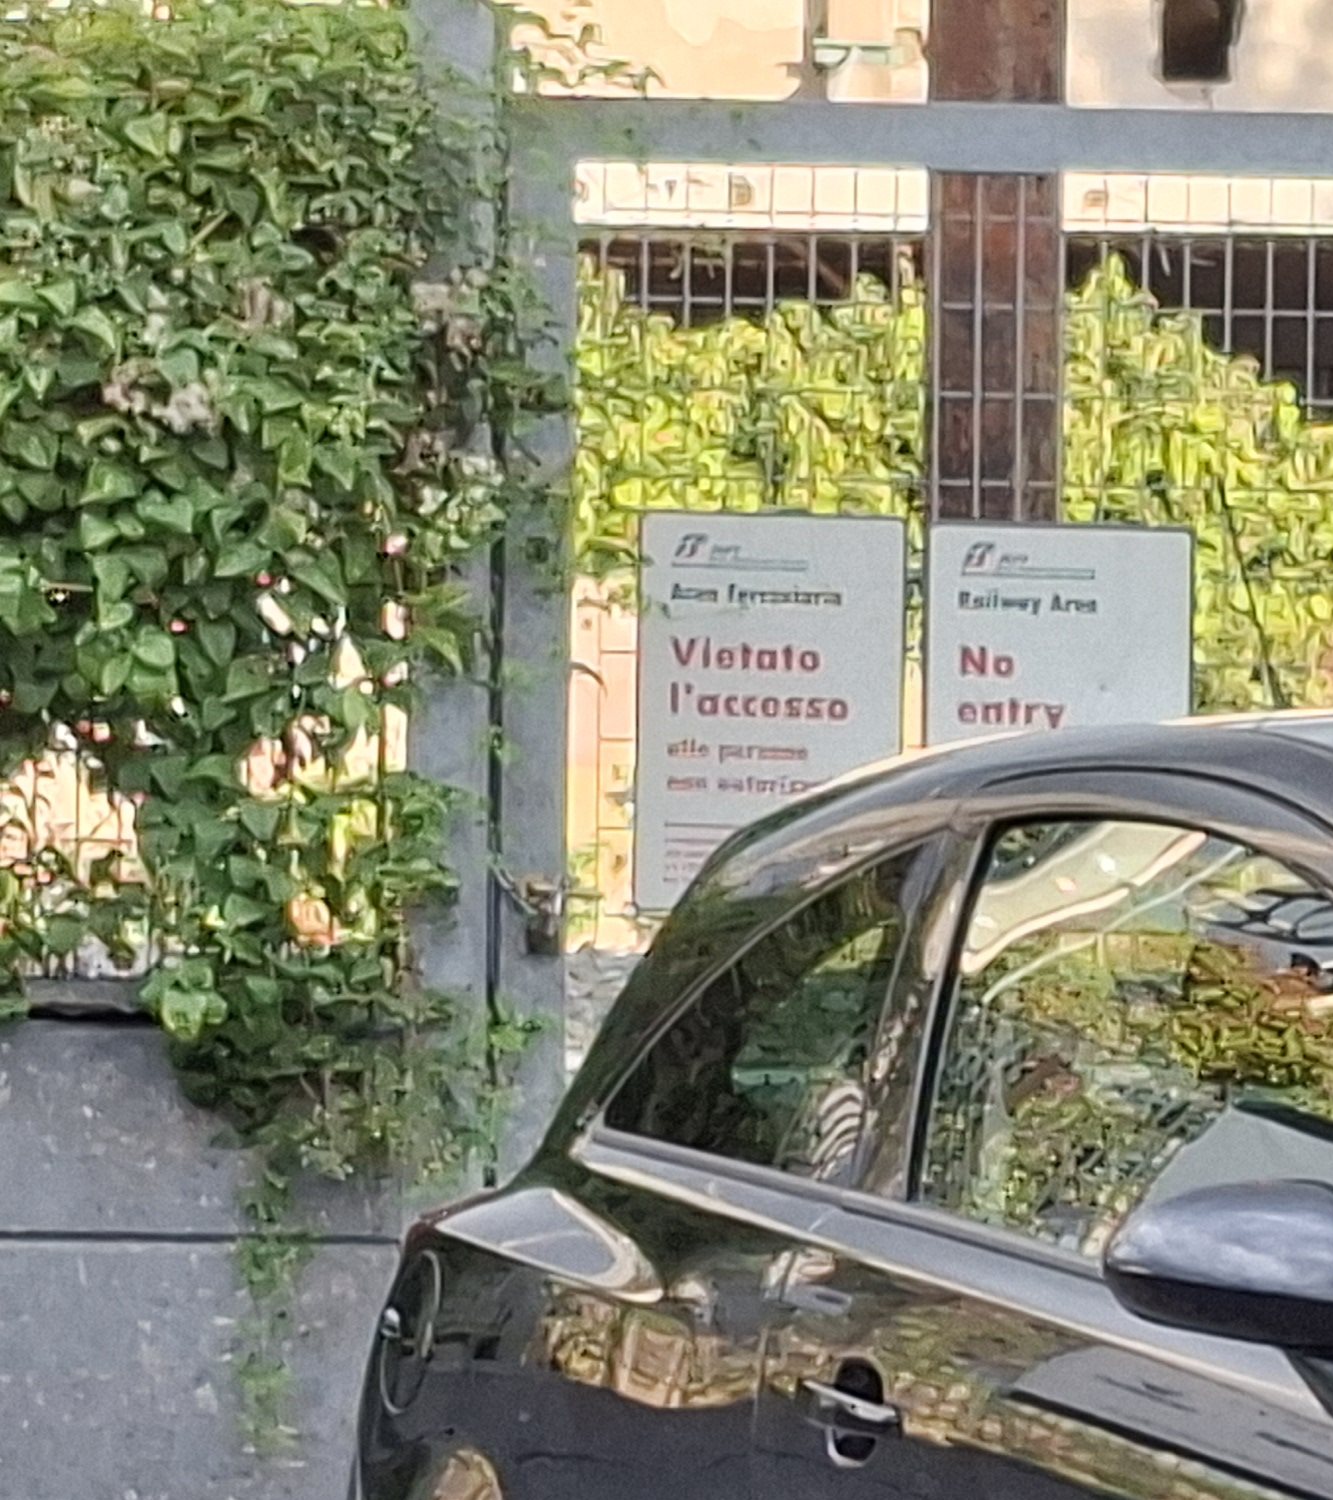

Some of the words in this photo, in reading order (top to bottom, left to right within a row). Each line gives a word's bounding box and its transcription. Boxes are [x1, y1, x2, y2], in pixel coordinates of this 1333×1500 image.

[671, 636, 820, 671] Vietato
[960, 645, 1014, 677] No
[957, 697, 1064, 729] entry
